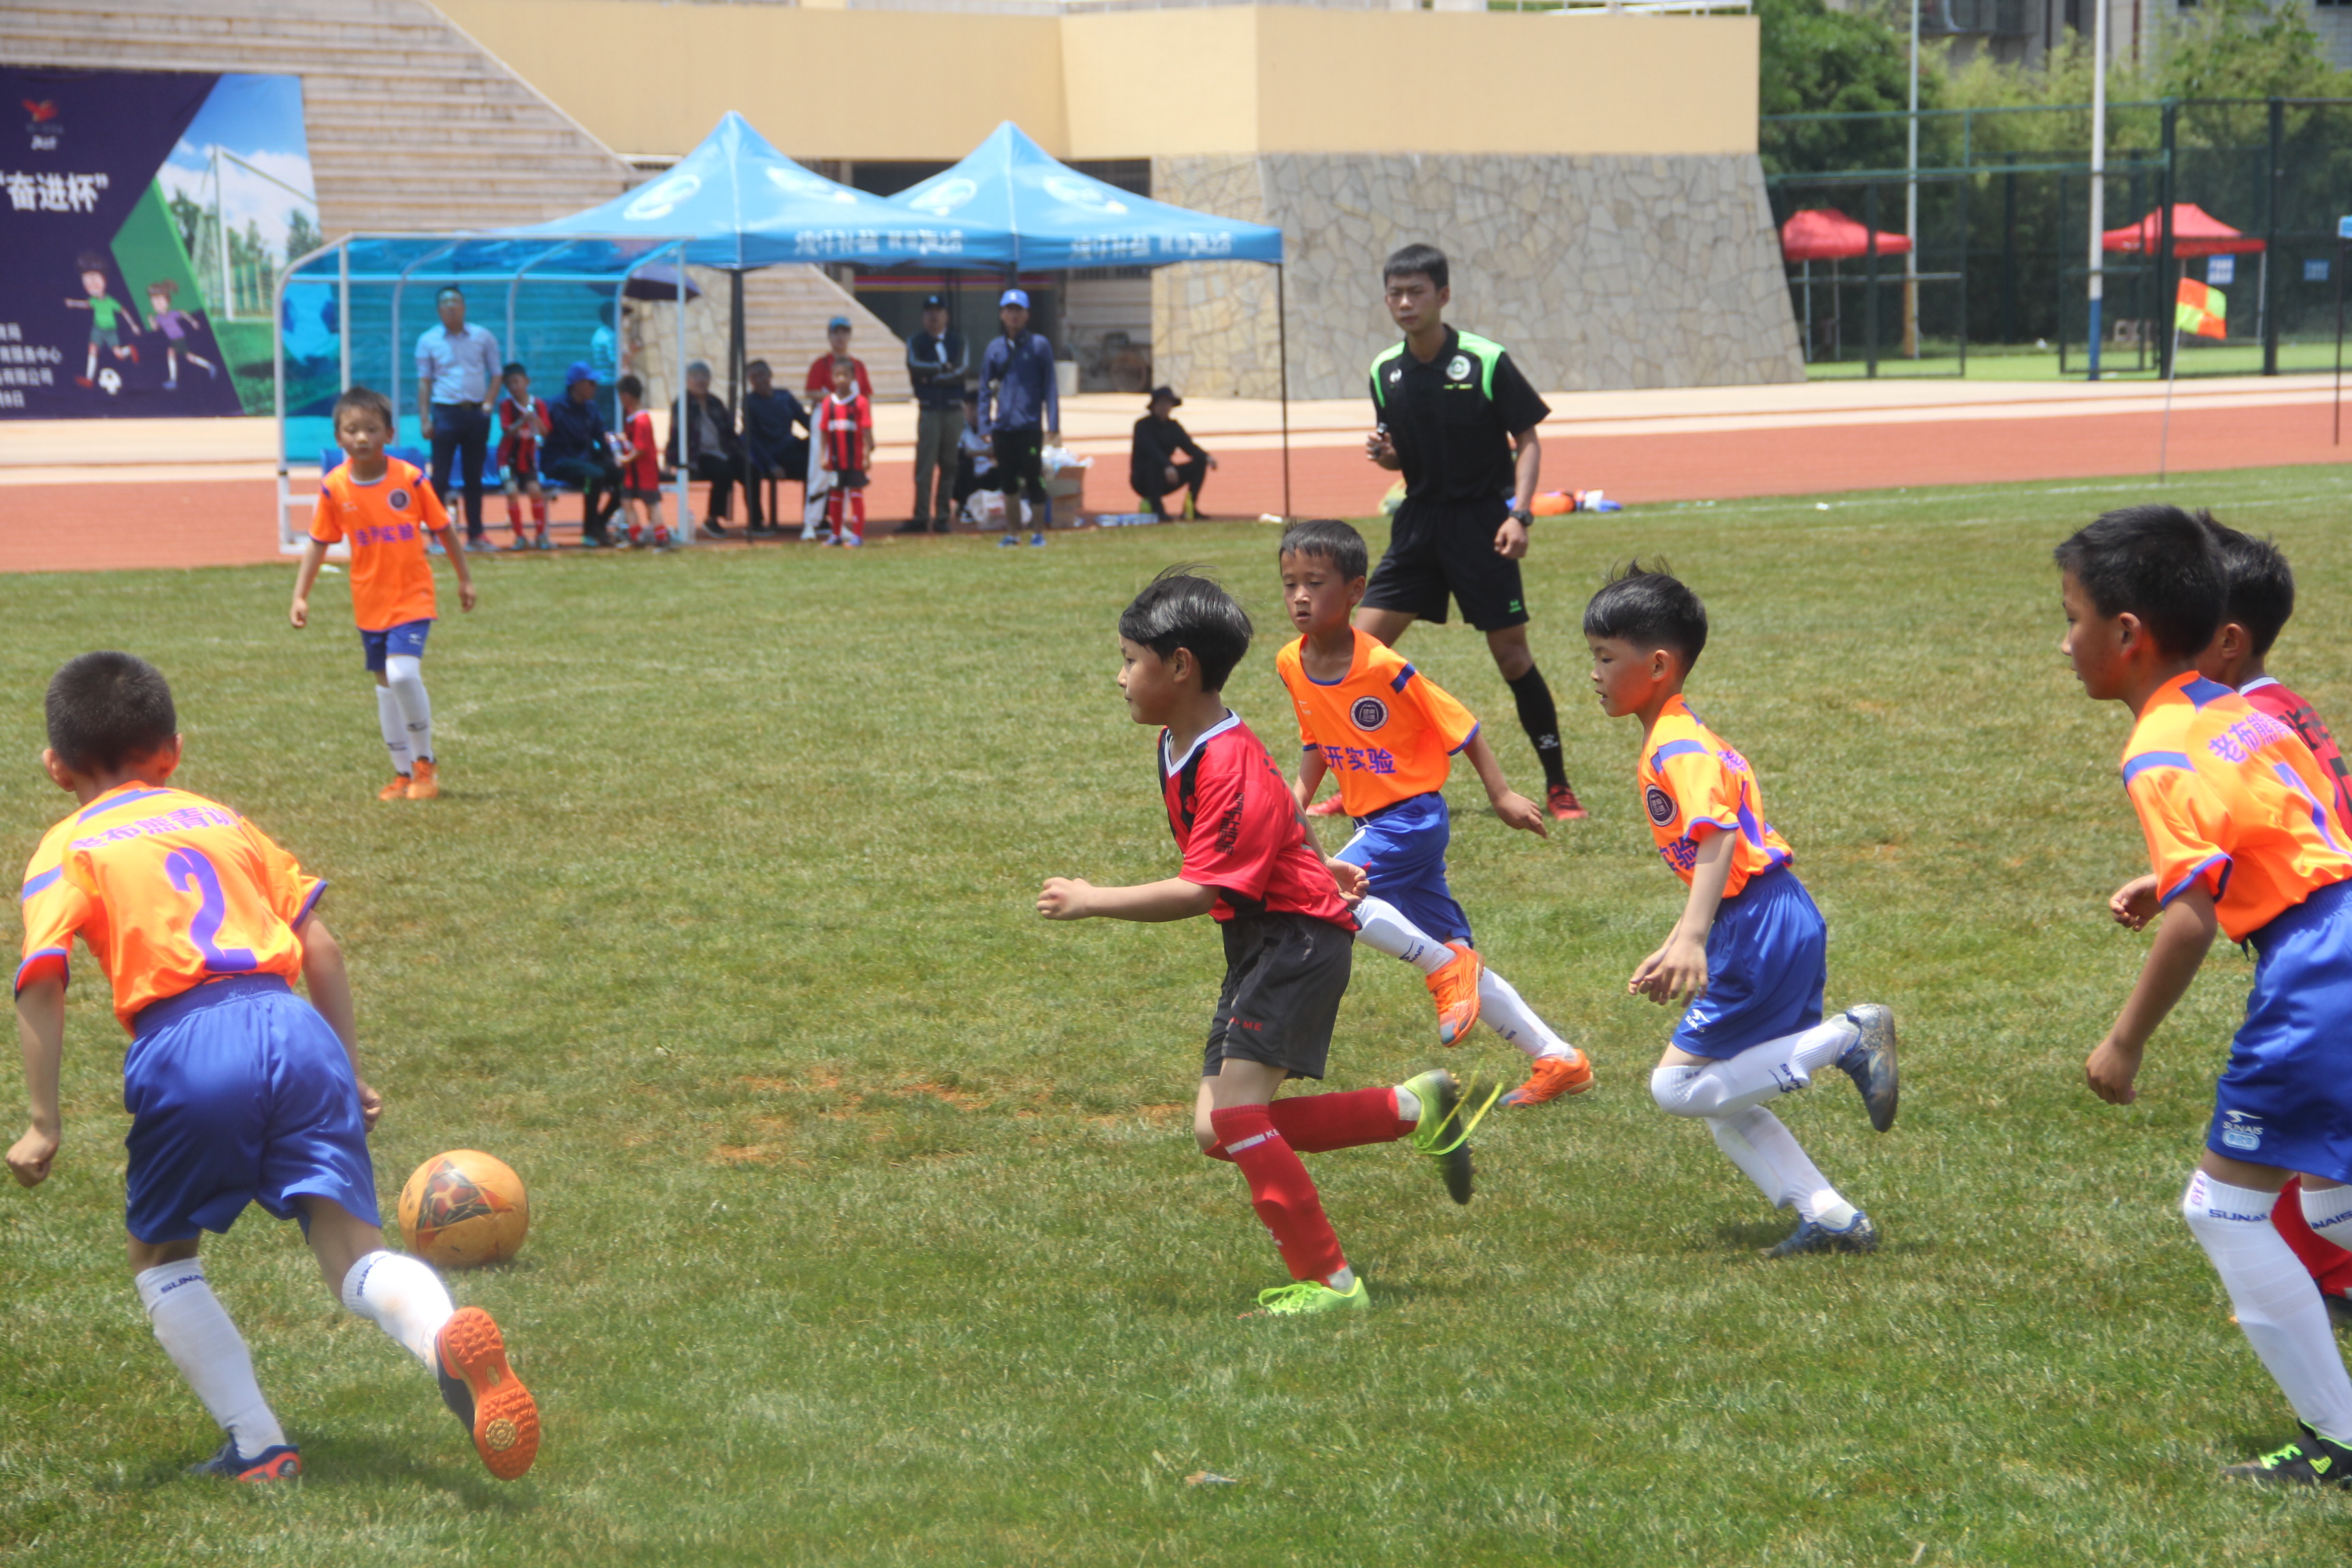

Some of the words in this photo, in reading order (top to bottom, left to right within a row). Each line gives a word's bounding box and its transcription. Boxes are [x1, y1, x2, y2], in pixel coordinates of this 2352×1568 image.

[0, 368, 53, 386] 有限公司
[165, 847, 257, 973] 2
